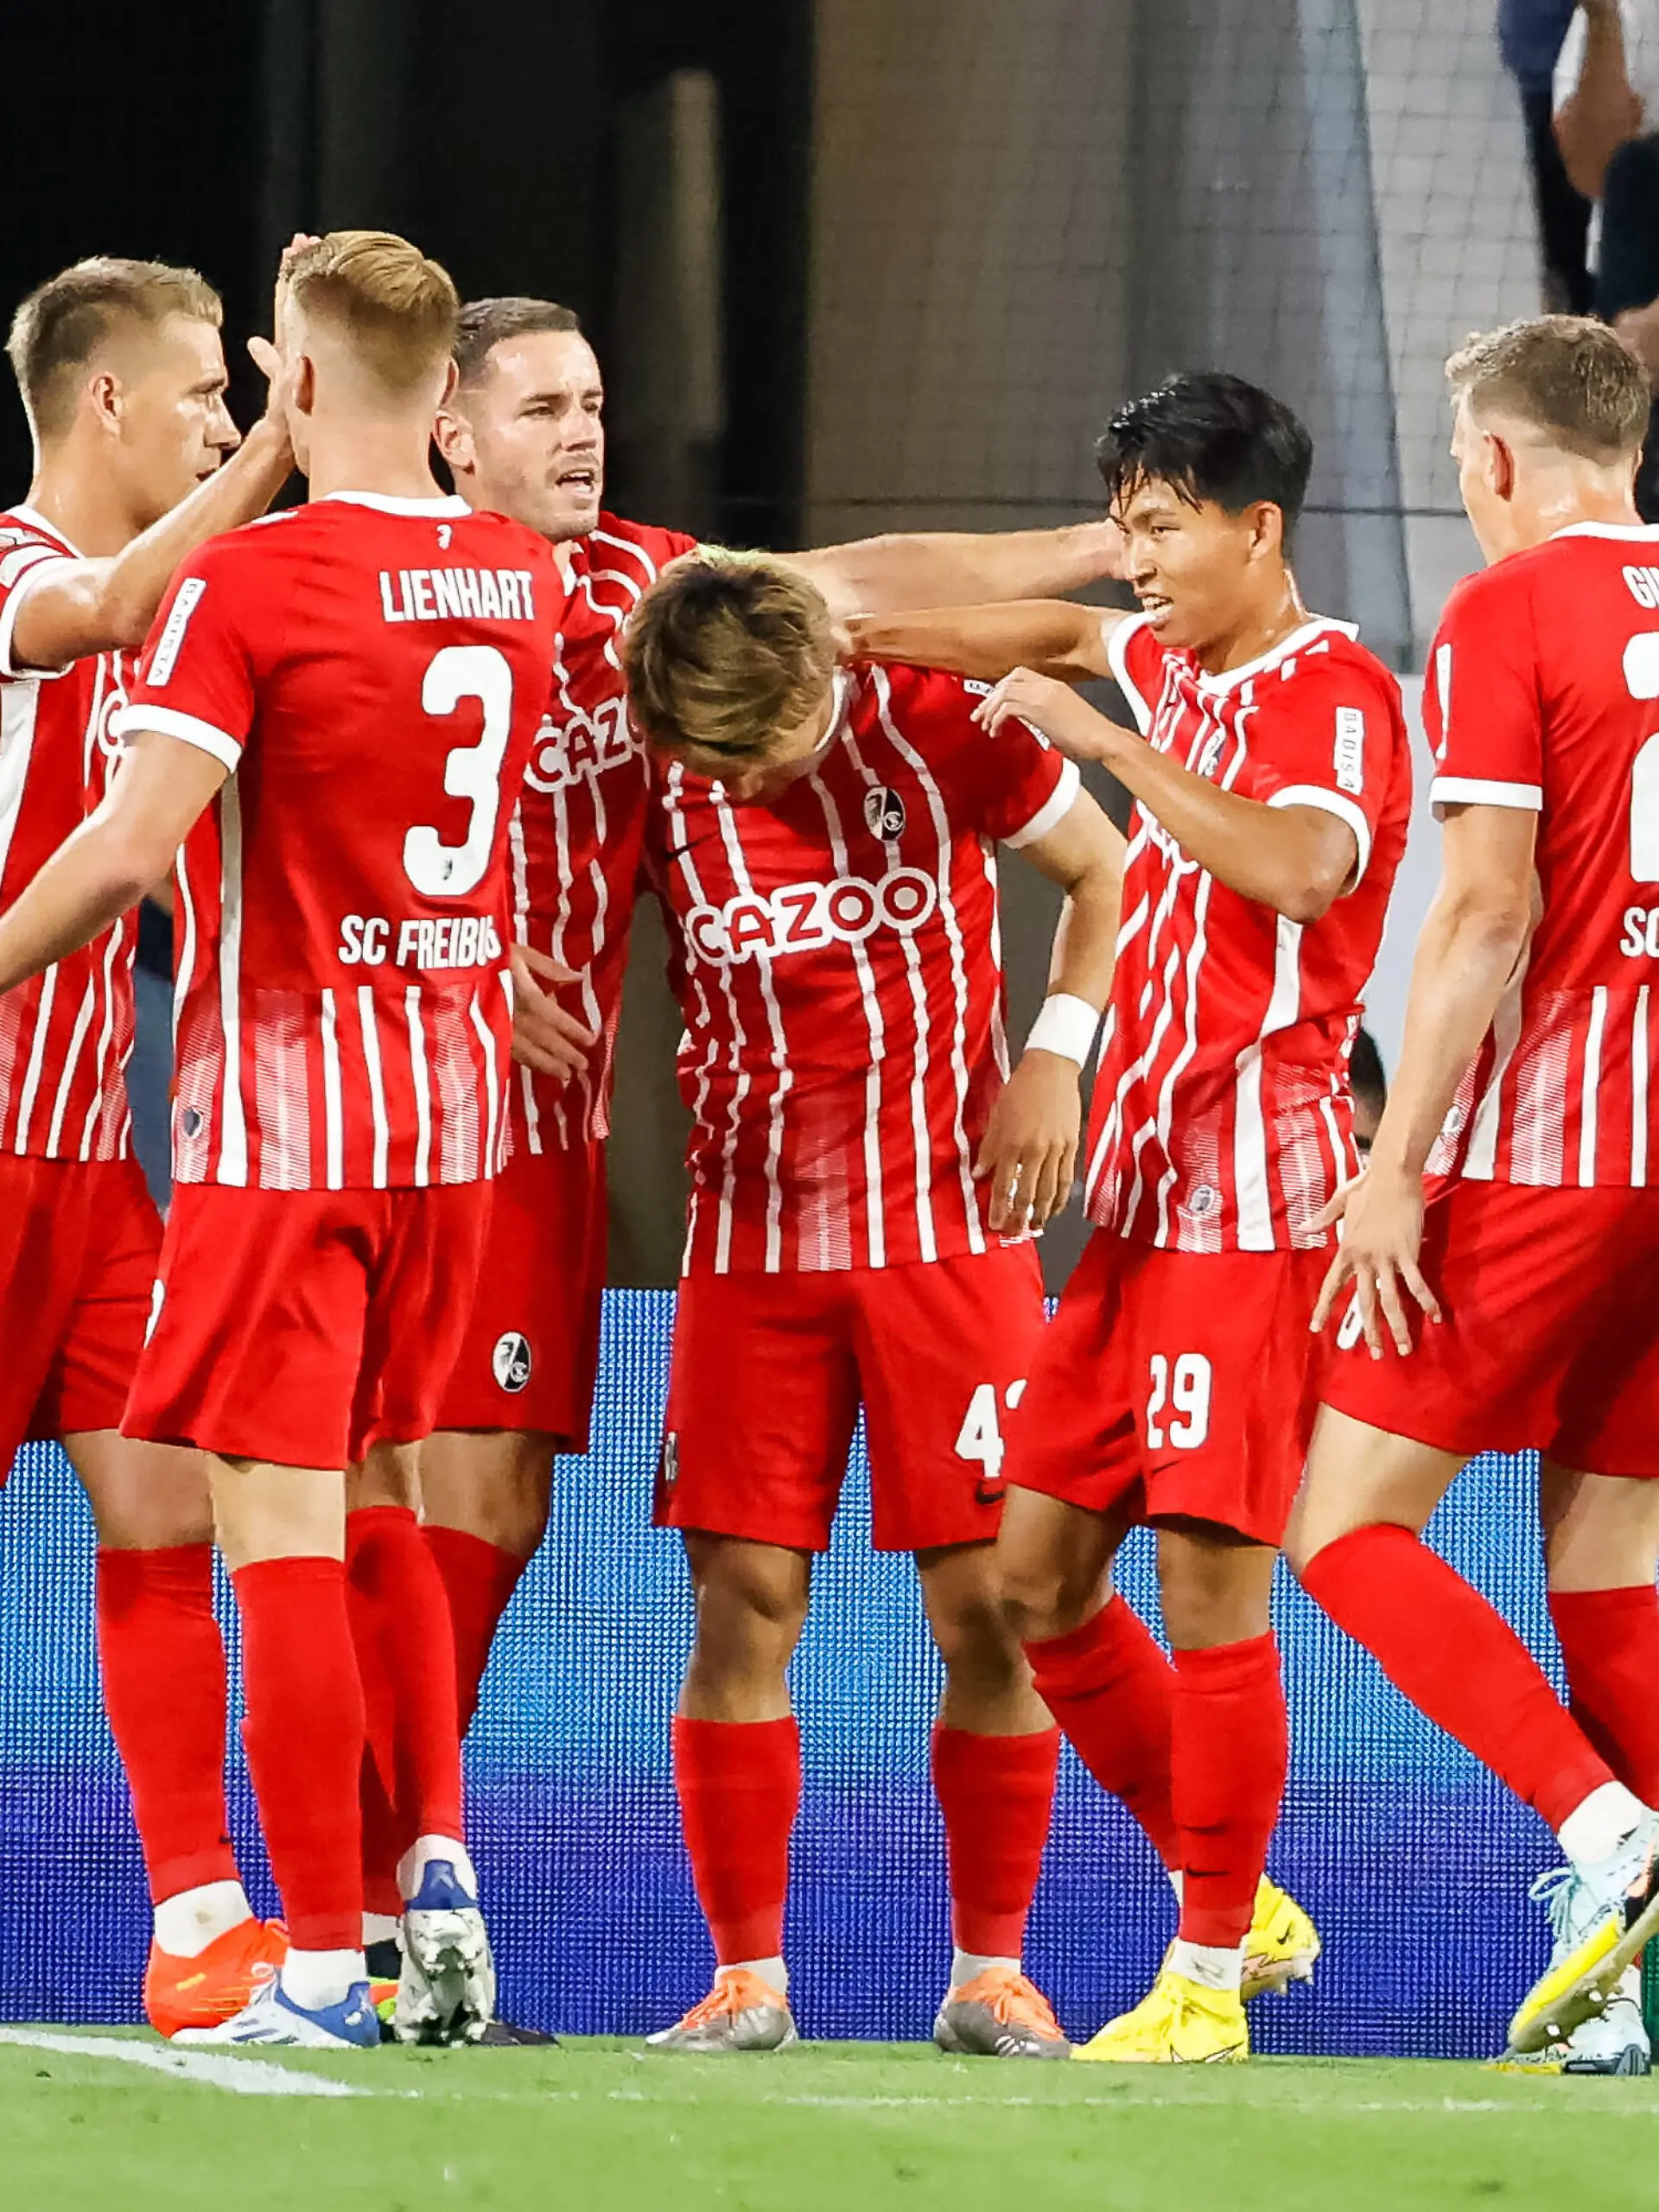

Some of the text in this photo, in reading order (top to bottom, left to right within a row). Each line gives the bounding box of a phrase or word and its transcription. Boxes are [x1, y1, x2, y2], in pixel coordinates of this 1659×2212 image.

[378, 567, 535, 622] LIENHART
[1622, 565, 1659, 608] GI
[402, 645, 512, 896] 3
[338, 913, 390, 966] SC
[689, 870, 933, 964] CAZOO
[1146, 1352, 1212, 1449] 29
